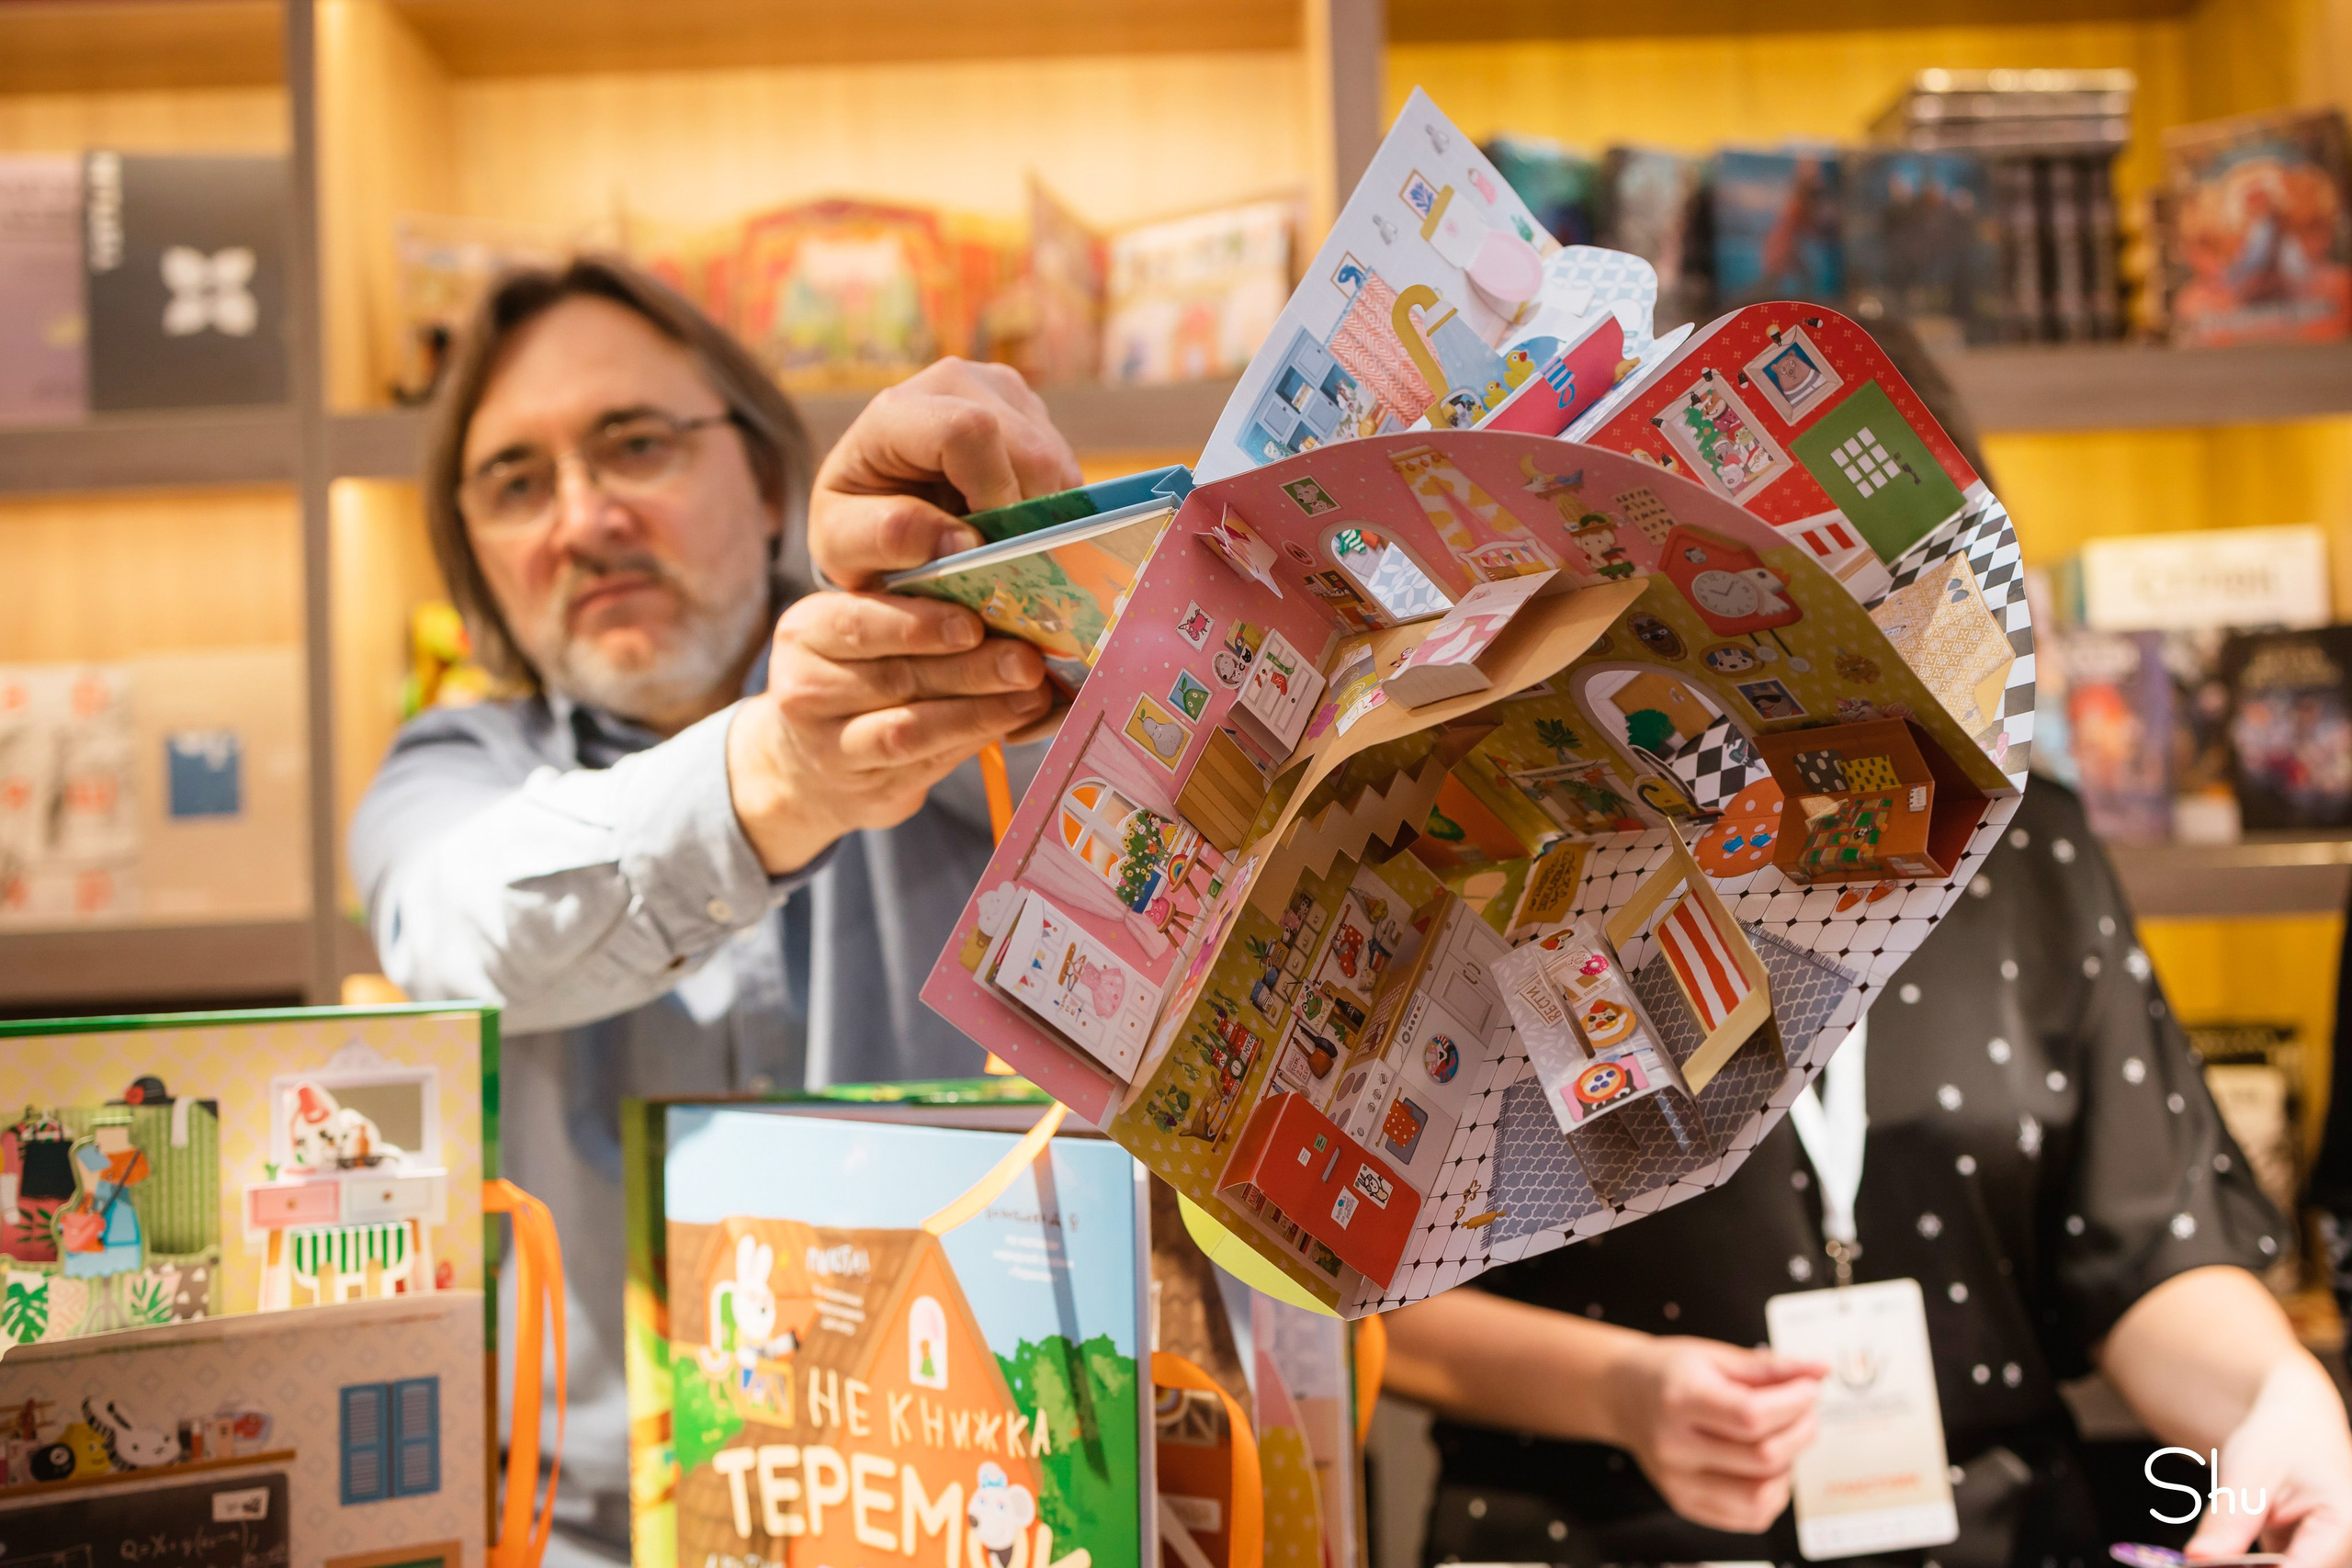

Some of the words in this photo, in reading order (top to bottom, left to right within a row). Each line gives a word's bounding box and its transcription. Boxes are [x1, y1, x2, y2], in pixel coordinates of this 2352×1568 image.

[1526, 985, 1563, 1023] ВЕСТИ
[1243, 1034, 1256, 1056] МУКА
[808, 1365, 872, 1438] НЕ
[887, 1390, 1052, 1459] КНИЖКА
